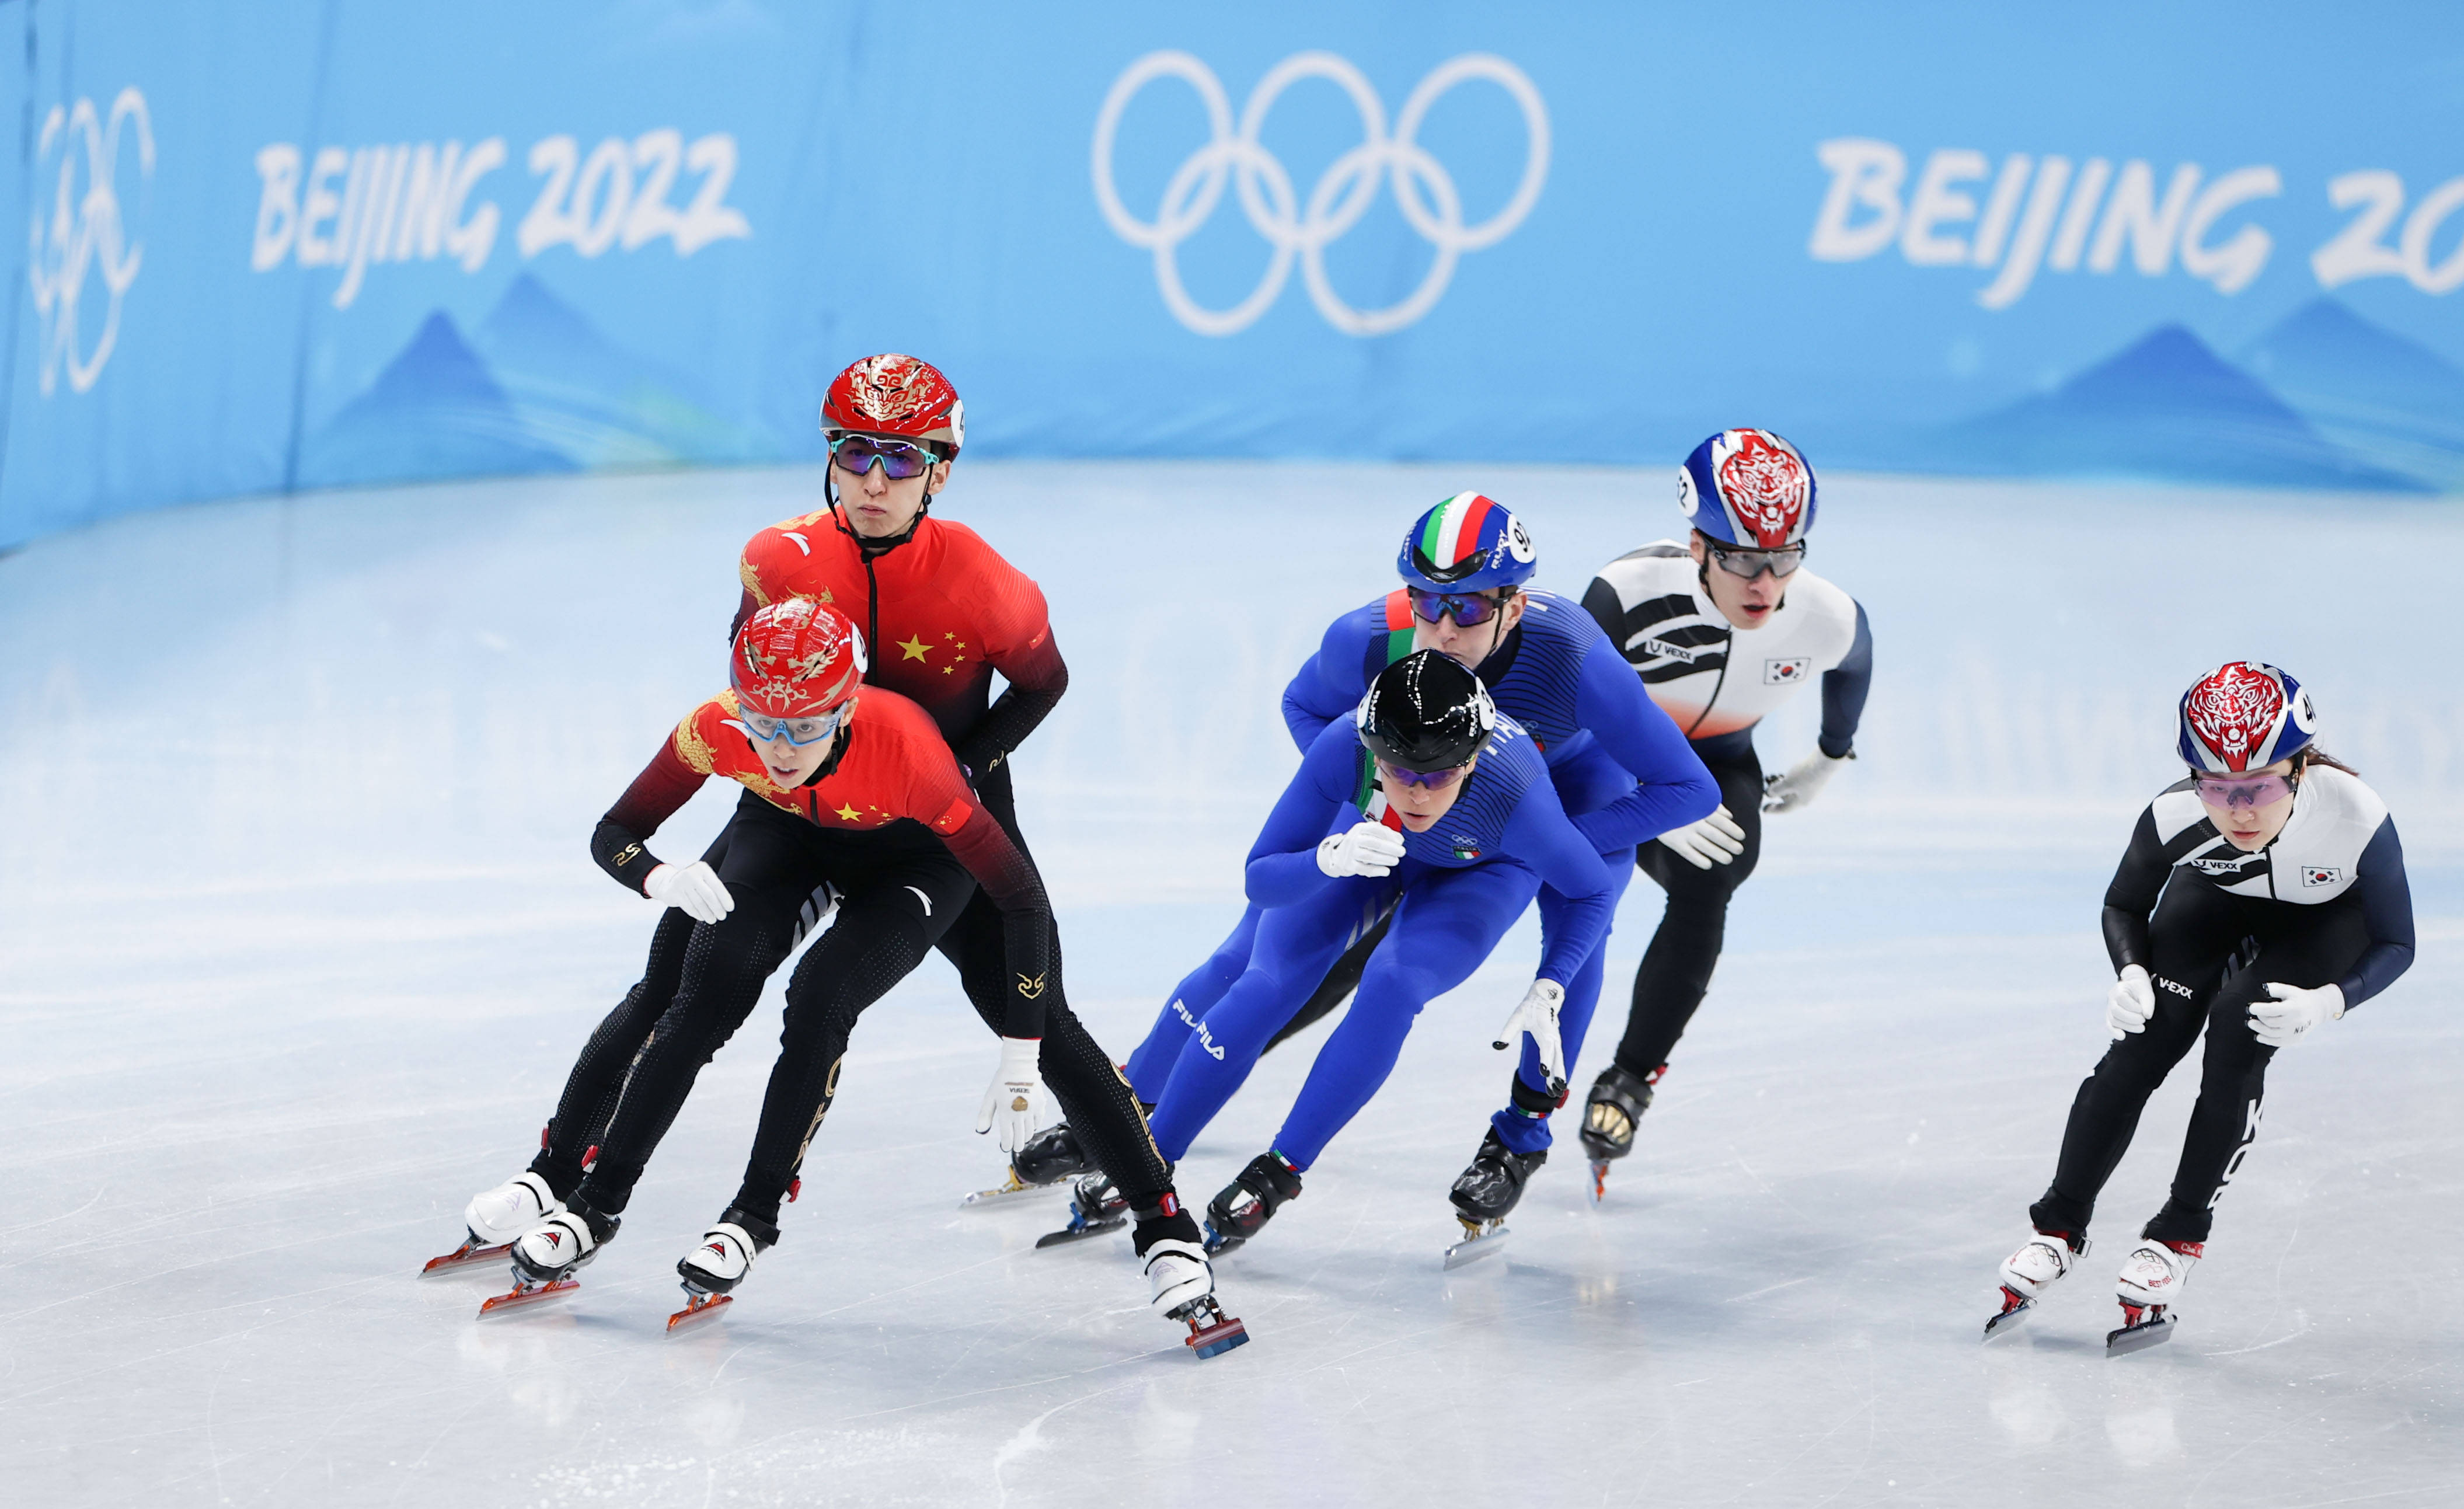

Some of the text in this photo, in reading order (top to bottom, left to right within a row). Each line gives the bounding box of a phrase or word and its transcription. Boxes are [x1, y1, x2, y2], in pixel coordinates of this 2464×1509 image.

[252, 128, 752, 309] BEIJING 2022
[1808, 137, 2464, 311] BEIJING 20
[1172, 998, 1197, 1027] FIL
[1196, 1020, 1225, 1060] FILA
